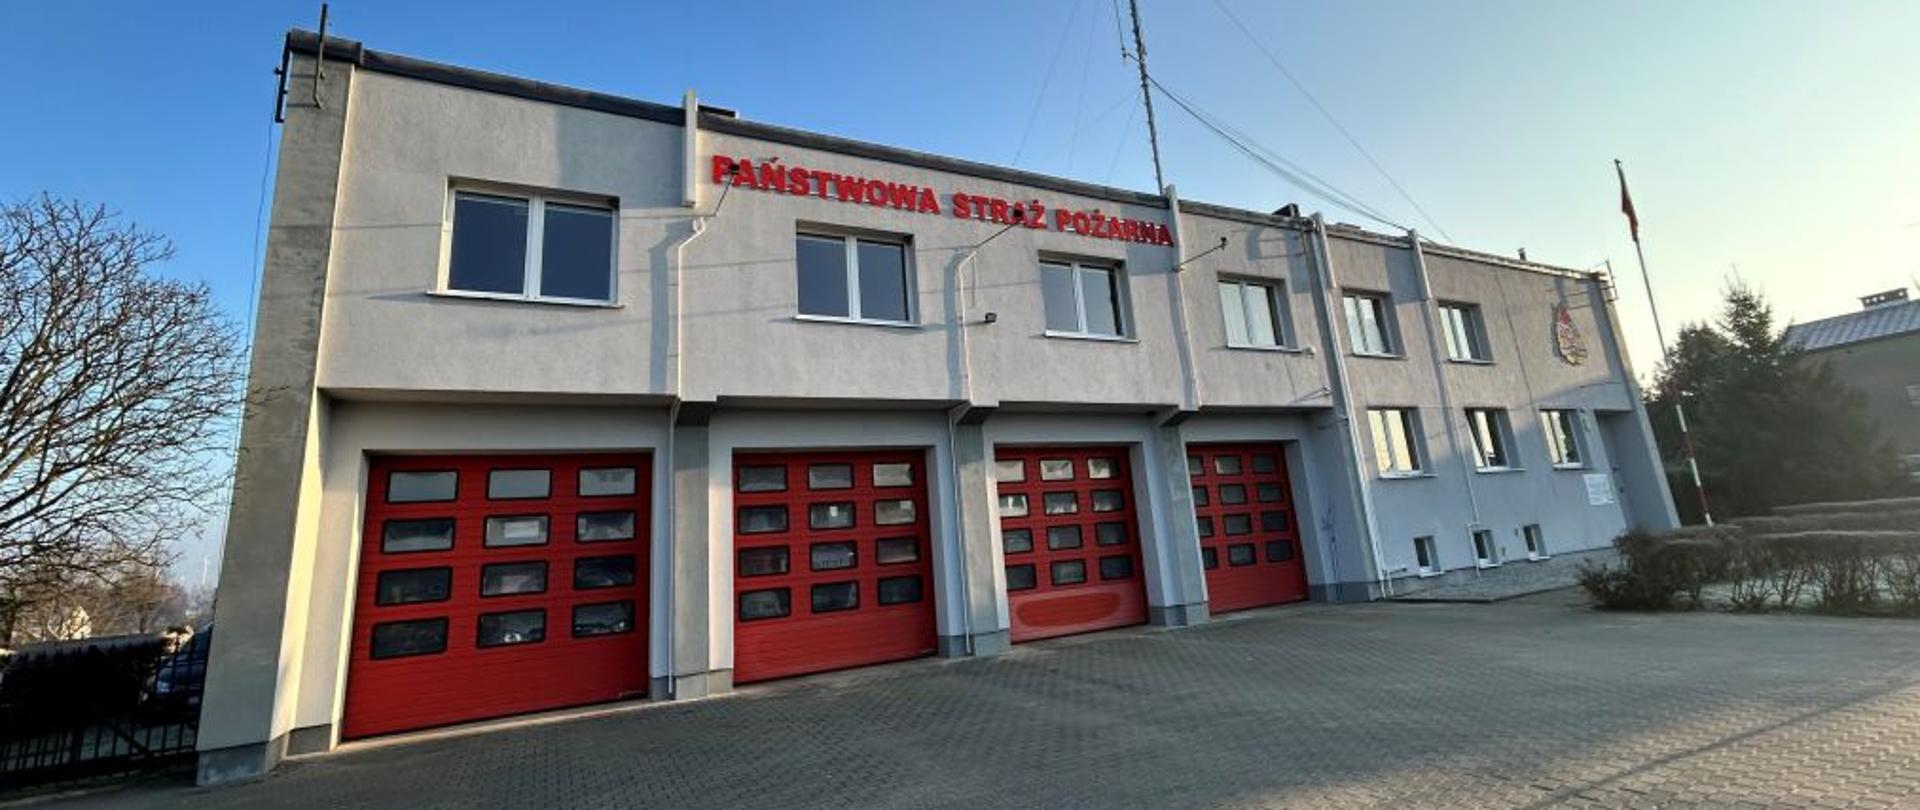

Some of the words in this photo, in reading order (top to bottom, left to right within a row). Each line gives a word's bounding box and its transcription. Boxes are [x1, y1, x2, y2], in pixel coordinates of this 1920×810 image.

[711, 154, 941, 215] PAŃSTWOWA
[952, 192, 1047, 229] STRAŻ
[1056, 208, 1174, 247] POŻARNA
